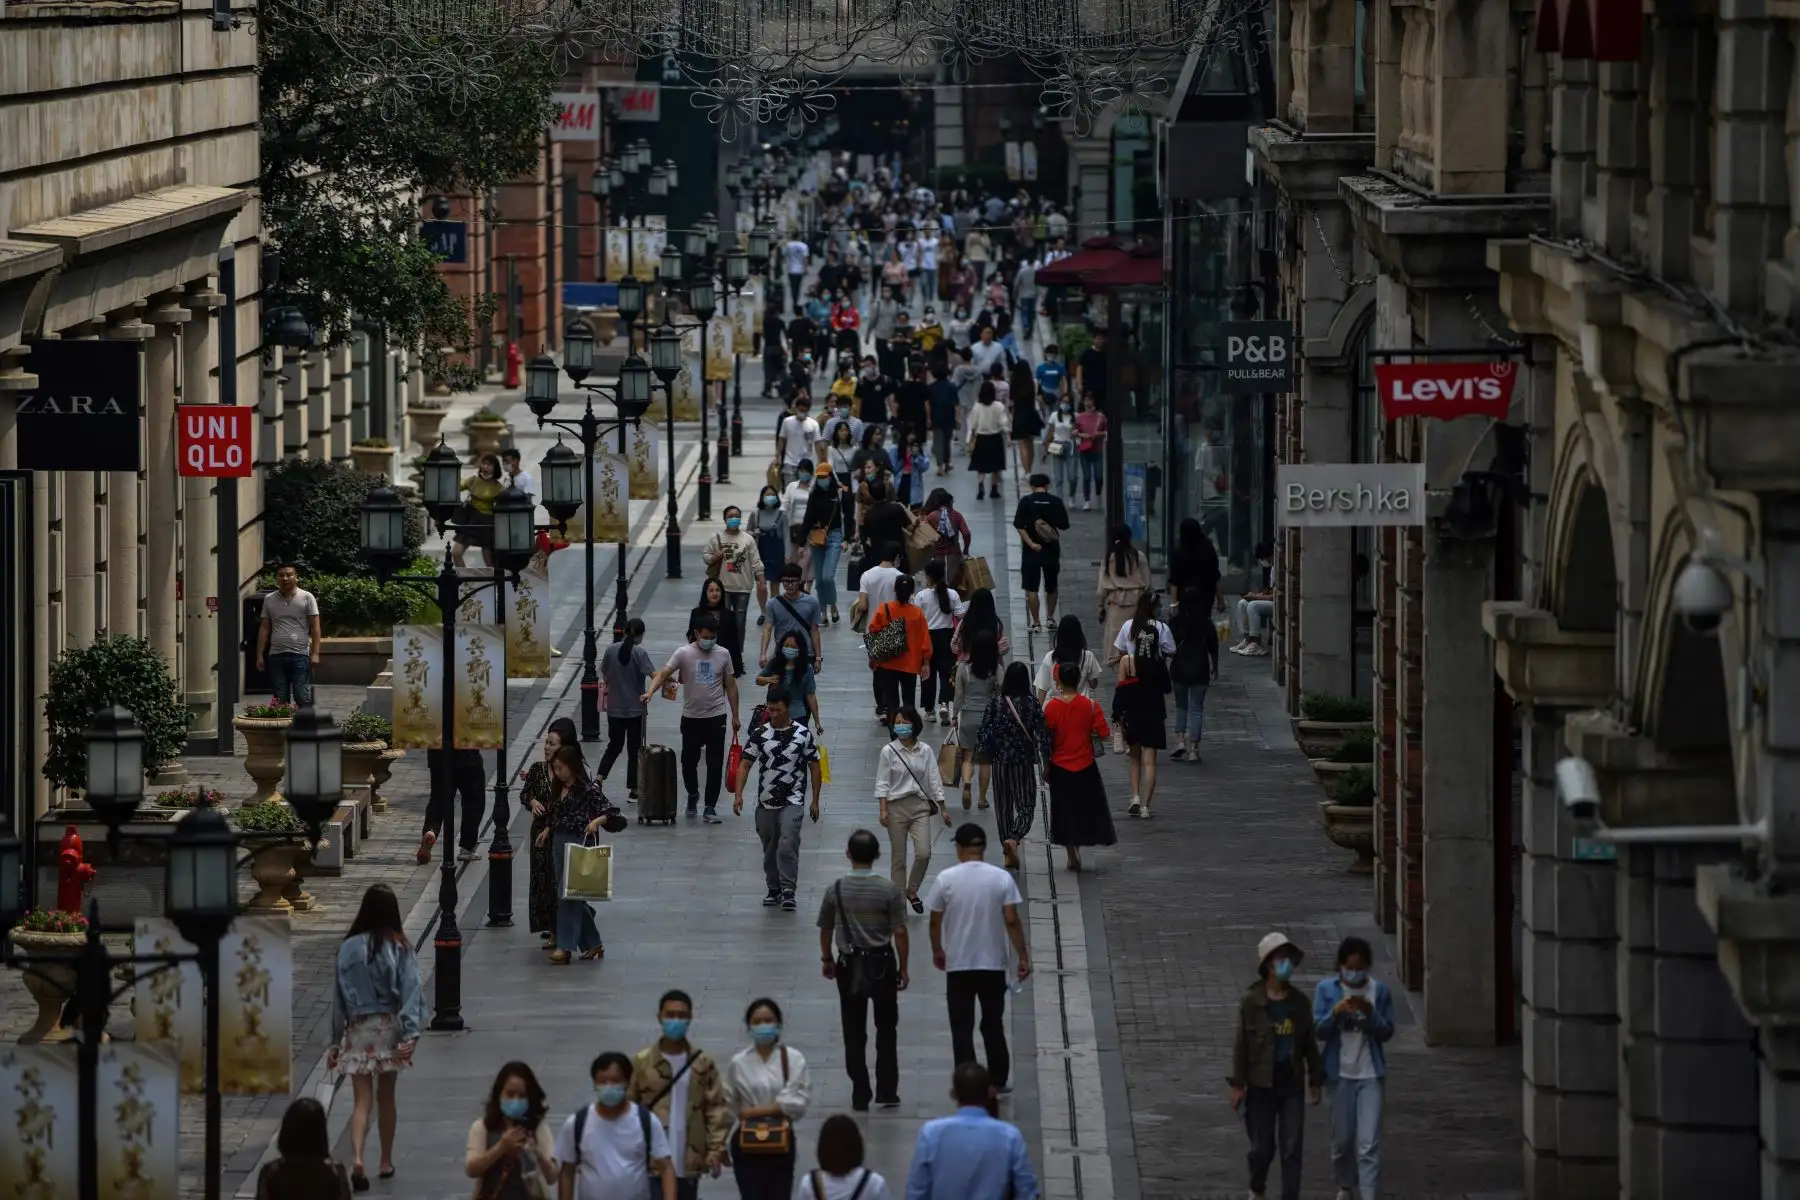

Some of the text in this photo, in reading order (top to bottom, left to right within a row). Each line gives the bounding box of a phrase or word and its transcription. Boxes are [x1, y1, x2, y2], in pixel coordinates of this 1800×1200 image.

[1227, 335, 1286, 363] P&B
[1228, 368, 1285, 380] PULL&BEAR
[15, 396, 127, 415] ZARA
[187, 415, 238, 439] UNI
[187, 444, 243, 472] QLO
[1286, 482, 1411, 512] Bershka
